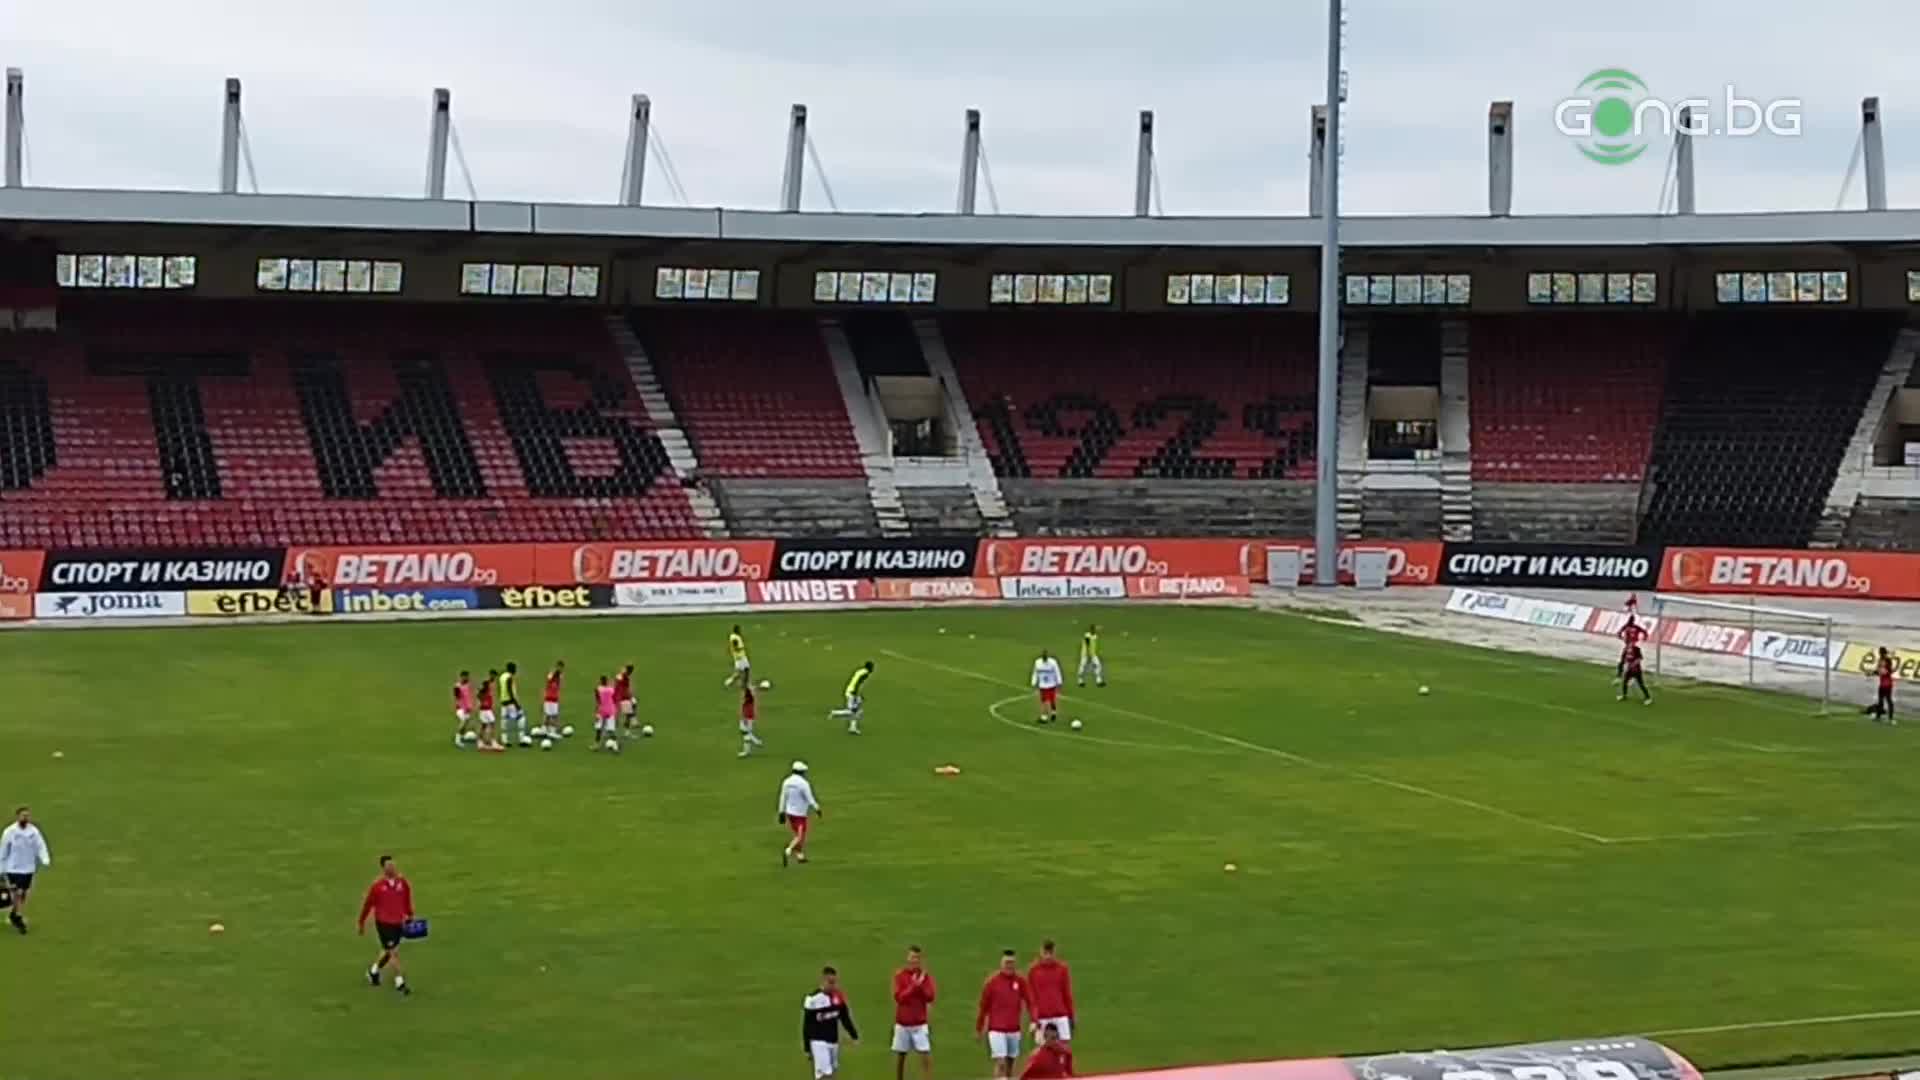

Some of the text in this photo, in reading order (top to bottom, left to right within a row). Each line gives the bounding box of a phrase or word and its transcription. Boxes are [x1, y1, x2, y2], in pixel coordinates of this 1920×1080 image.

[52, 560, 270, 584] СПОРТ И КАЗИНО
[780, 549, 966, 572] СПОРТ И КАЗИНО
[1449, 553, 1649, 579] СПОРТ И КАЗИНО
[502, 586, 592, 608] efbet
[757, 579, 858, 602] WINBET
